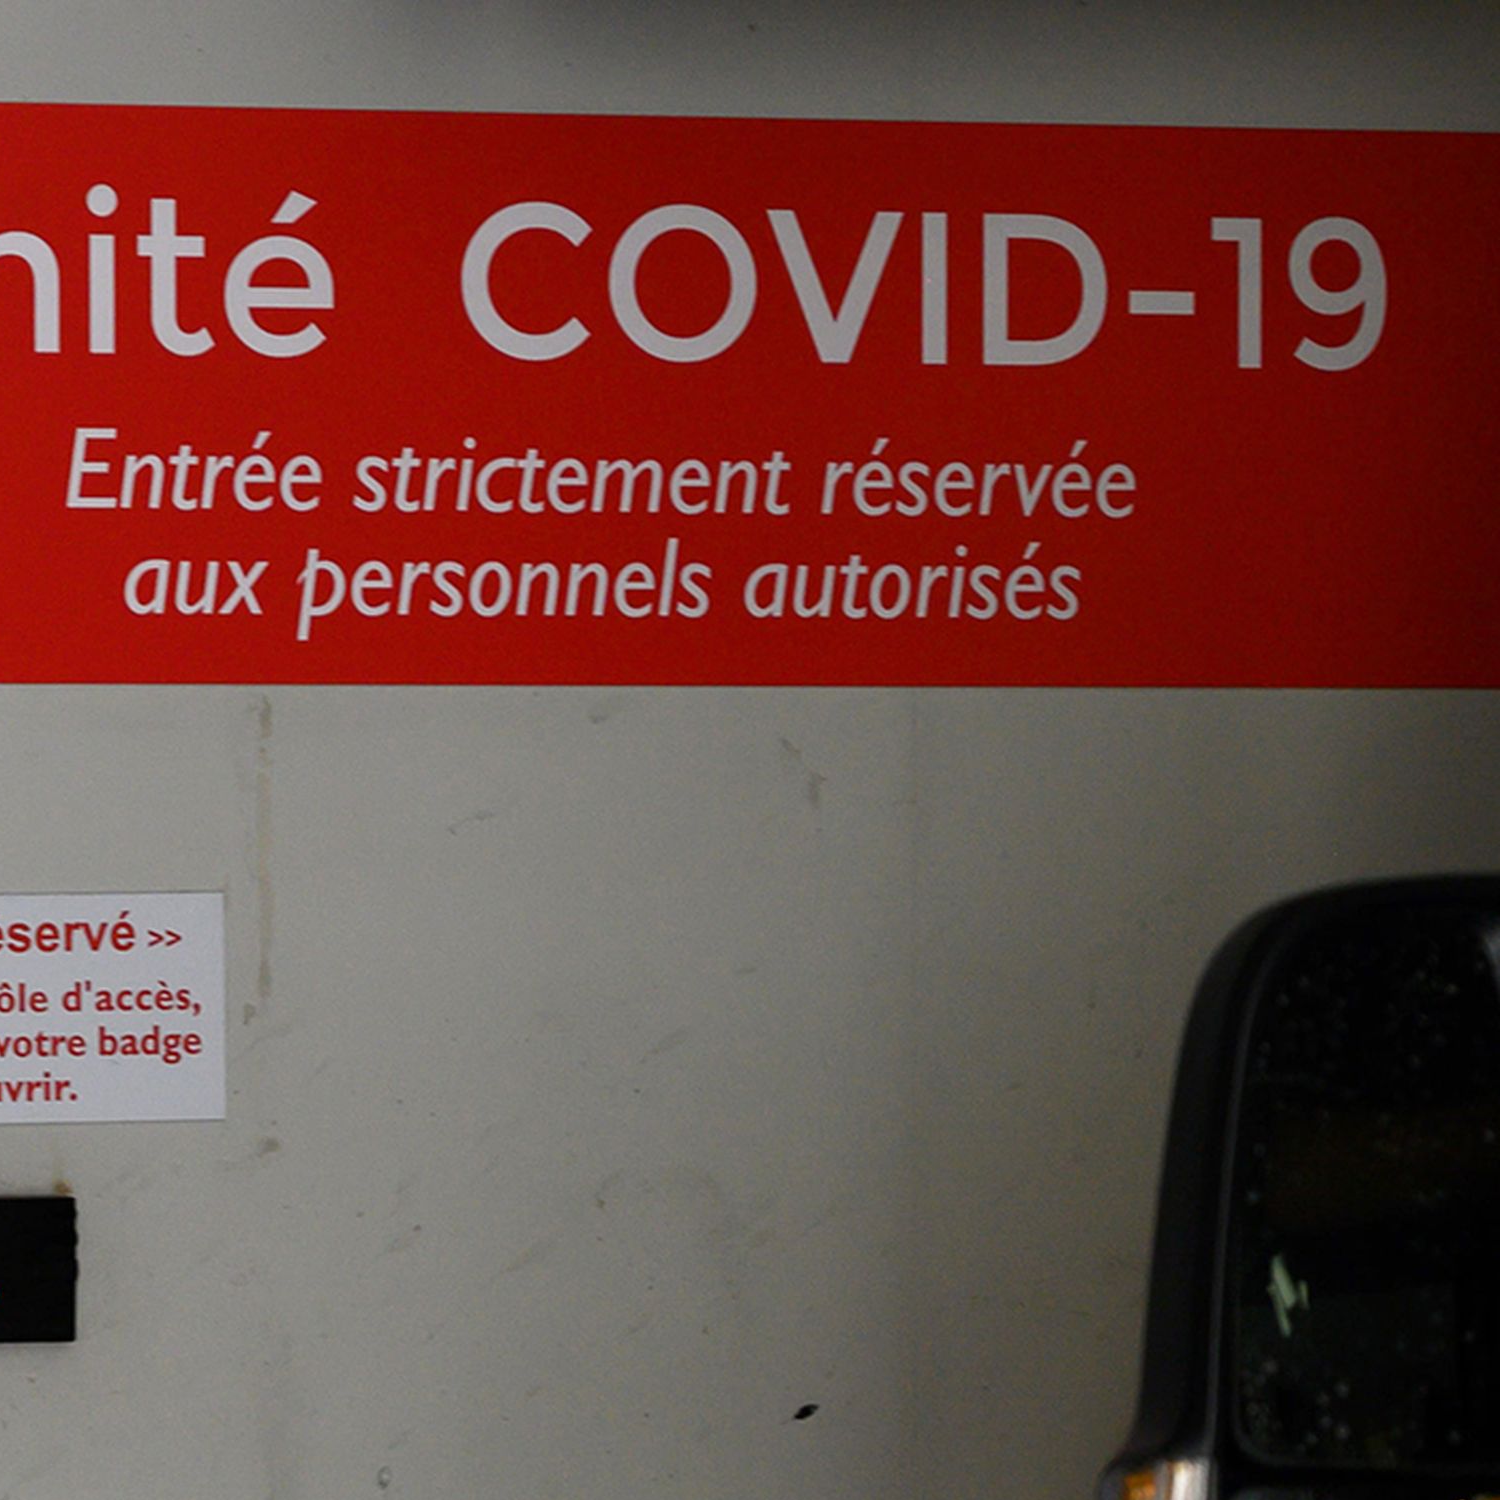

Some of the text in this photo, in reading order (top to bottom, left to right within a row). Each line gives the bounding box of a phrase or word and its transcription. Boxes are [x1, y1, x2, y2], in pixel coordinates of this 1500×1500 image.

[460, 200, 1386, 372] COVID-19
[64, 426, 1136, 519] Entrée strictement réservée
[123, 536, 1081, 642] aux personnels autorisés
[61, 980, 202, 1015] d'accès,
[97, 1024, 202, 1066] badge
